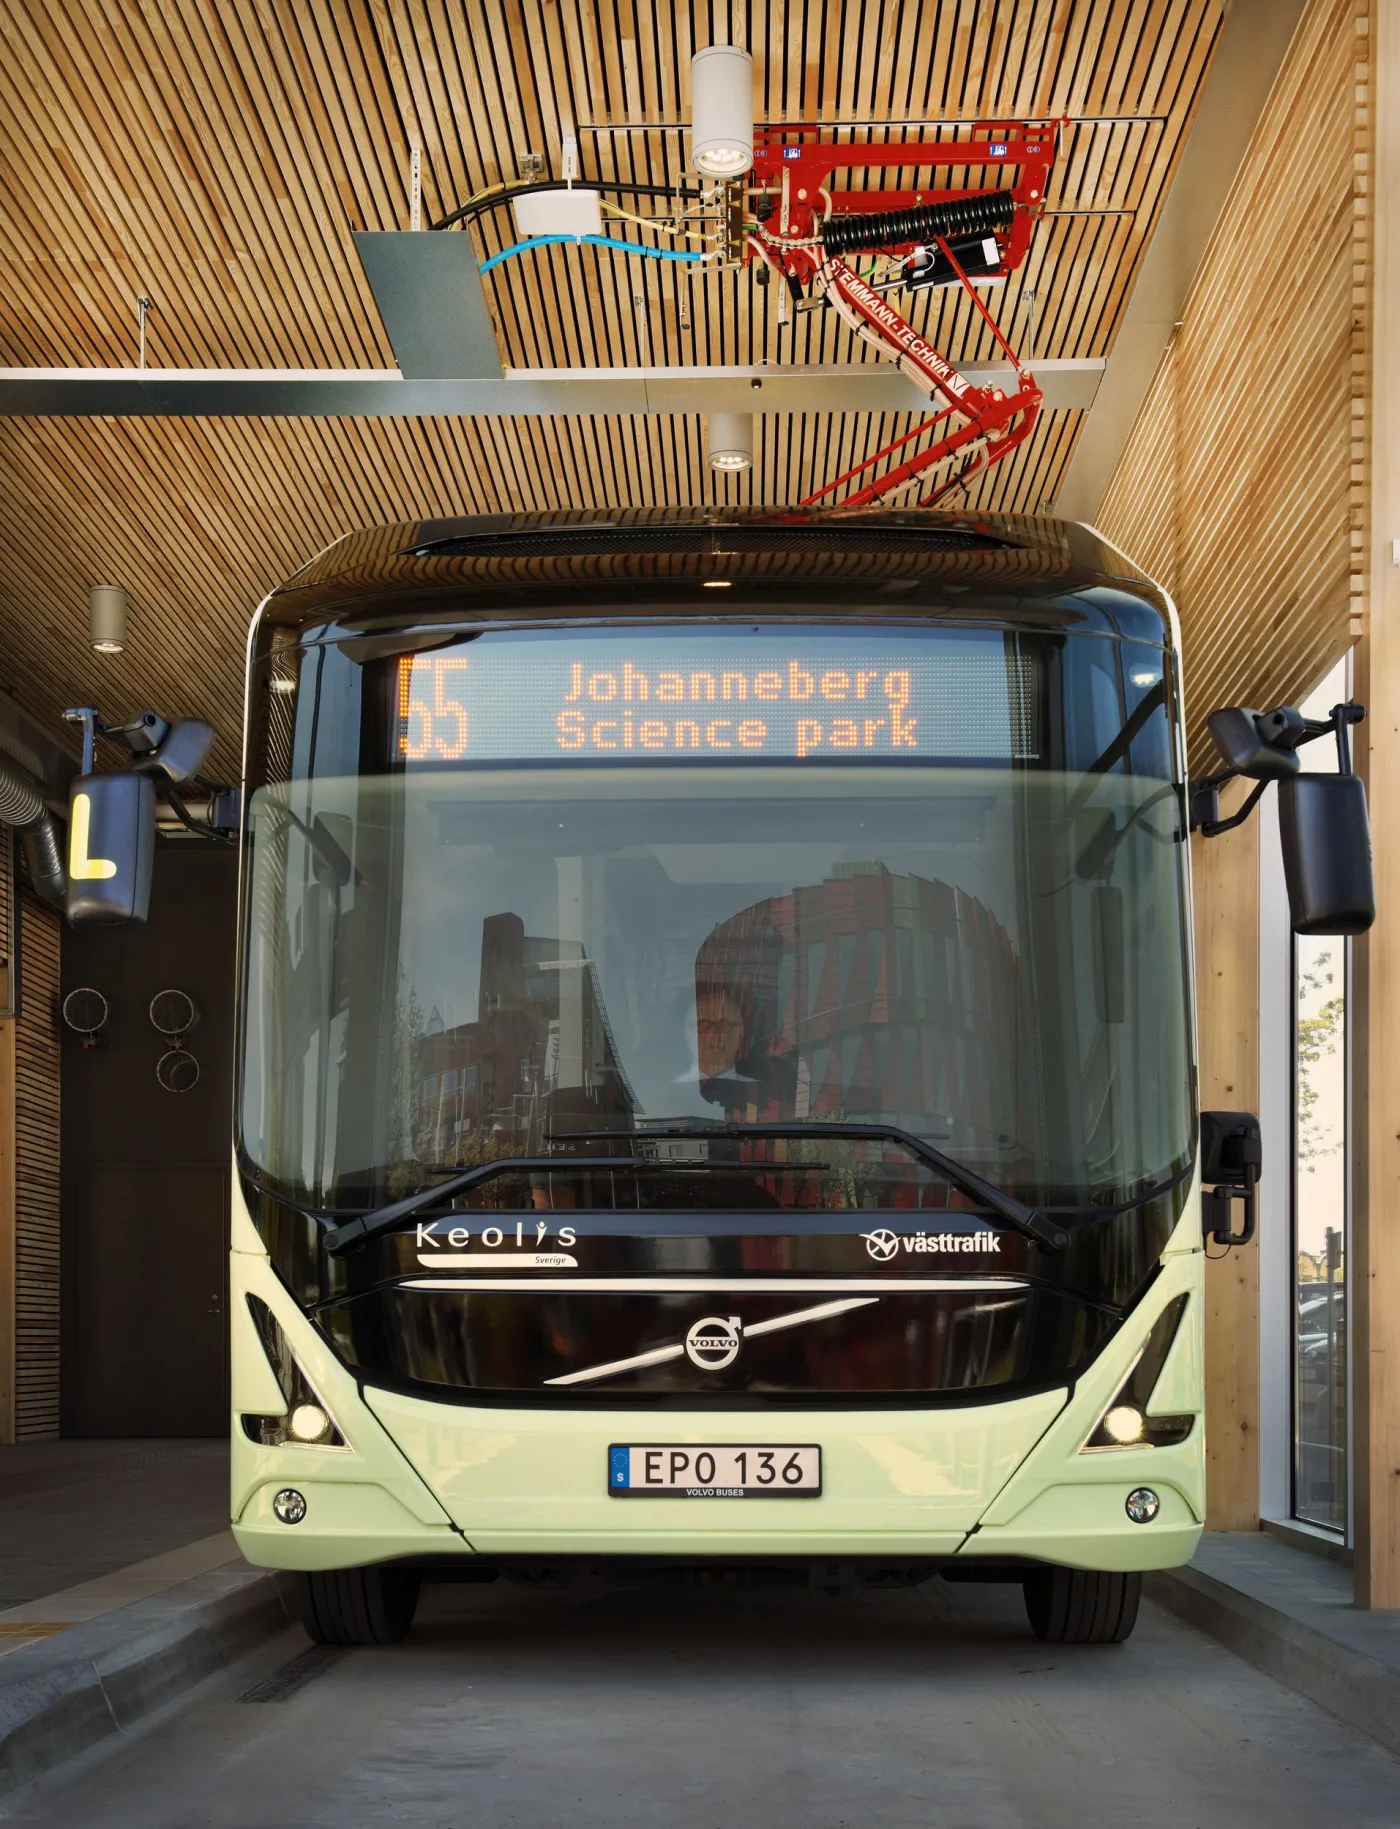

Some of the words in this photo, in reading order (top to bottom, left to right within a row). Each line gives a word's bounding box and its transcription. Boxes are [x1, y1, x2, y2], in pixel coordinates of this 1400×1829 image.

[830, 258, 954, 379] STEMMANN-TECHNIK
[563, 660, 911, 709] Johanneberg
[398, 657, 468, 759] 55
[556, 709, 768, 749] Science
[796, 708, 918, 758] park
[416, 1221, 577, 1248] Keolis
[902, 1231, 1001, 1253] västtrafik
[534, 1255, 567, 1266] Sverige
[688, 1339, 738, 1348] VOLVO
[616, 1472, 625, 1483] S
[734, 1451, 804, 1485] 136
[686, 1488, 714, 1497] VOLVO
[716, 1488, 744, 1497] BUSES
